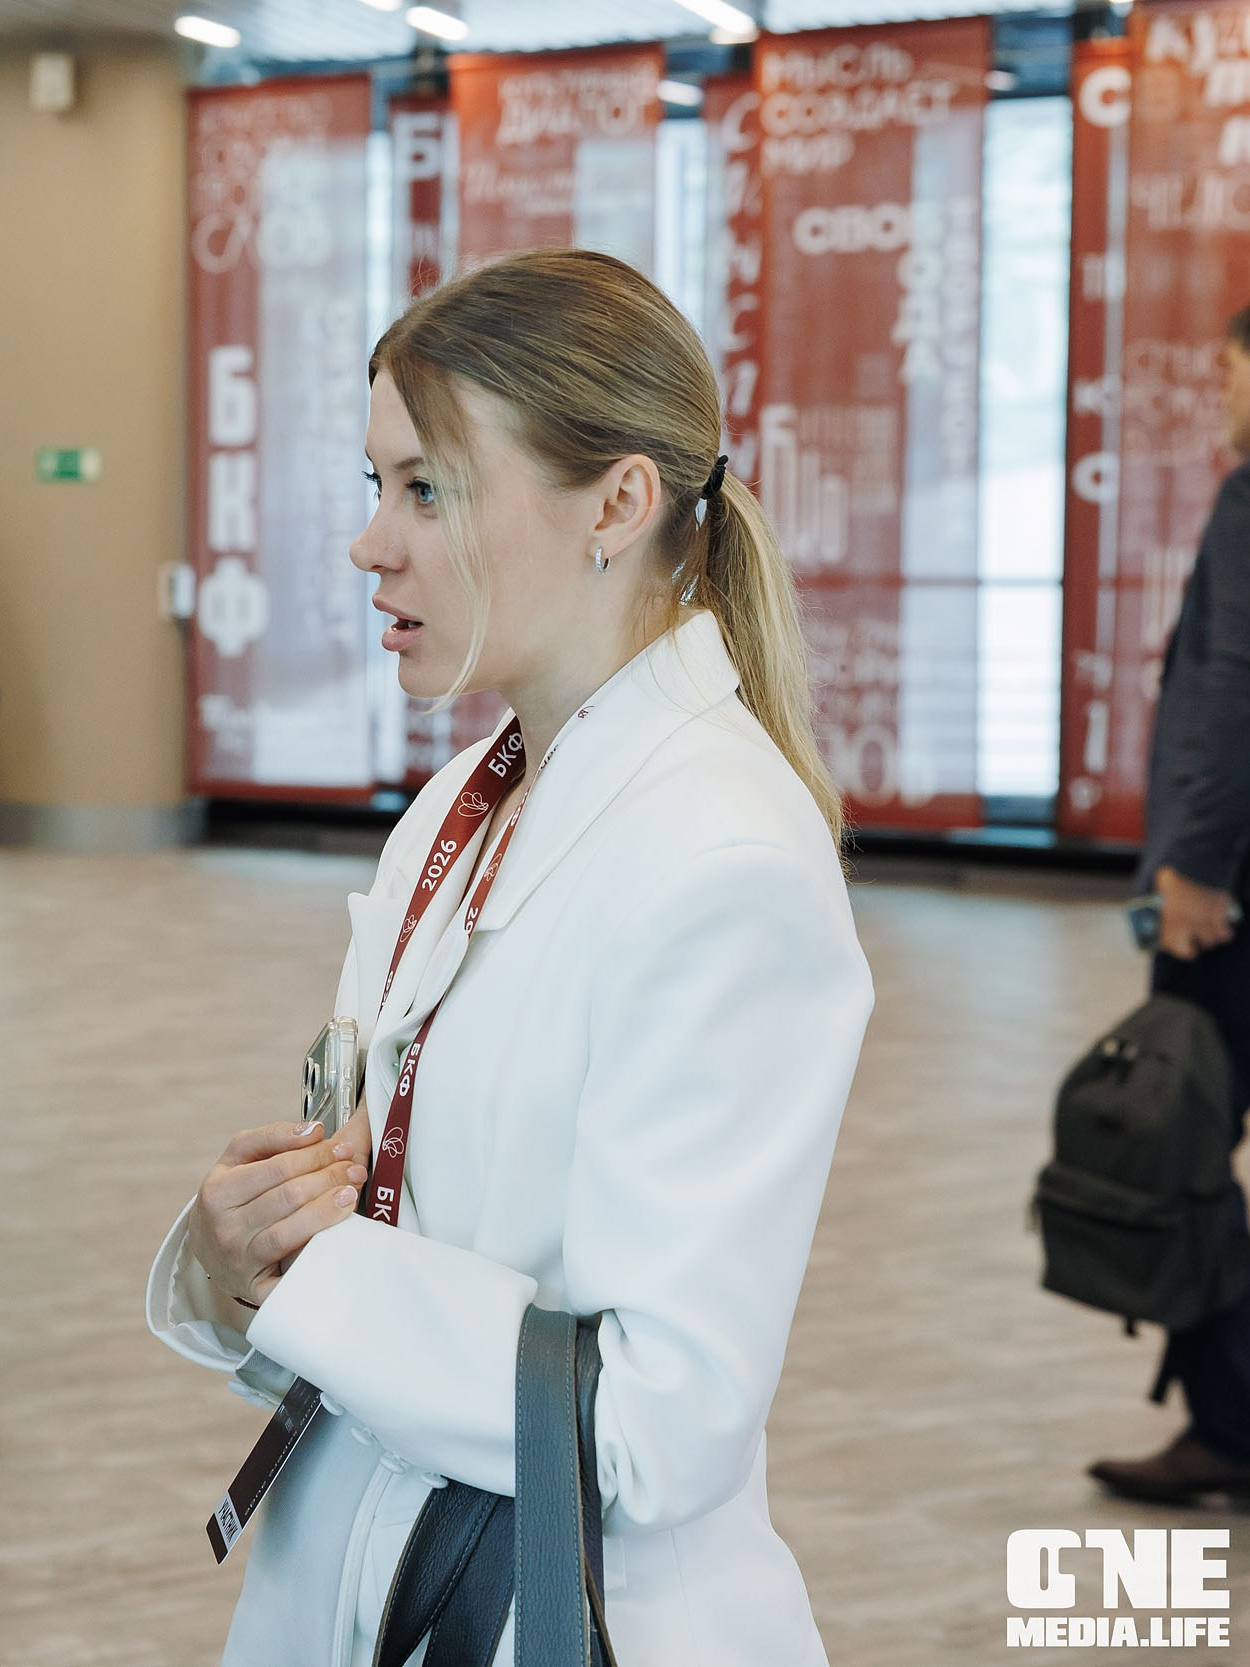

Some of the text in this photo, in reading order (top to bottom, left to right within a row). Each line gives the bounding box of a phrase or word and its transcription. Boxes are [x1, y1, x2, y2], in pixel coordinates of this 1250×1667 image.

[198, 345, 270, 658] БКФ
[488, 732, 523, 778] БКФ
[422, 839, 457, 891] 2026
[399, 1042, 421, 1097] БКФ
